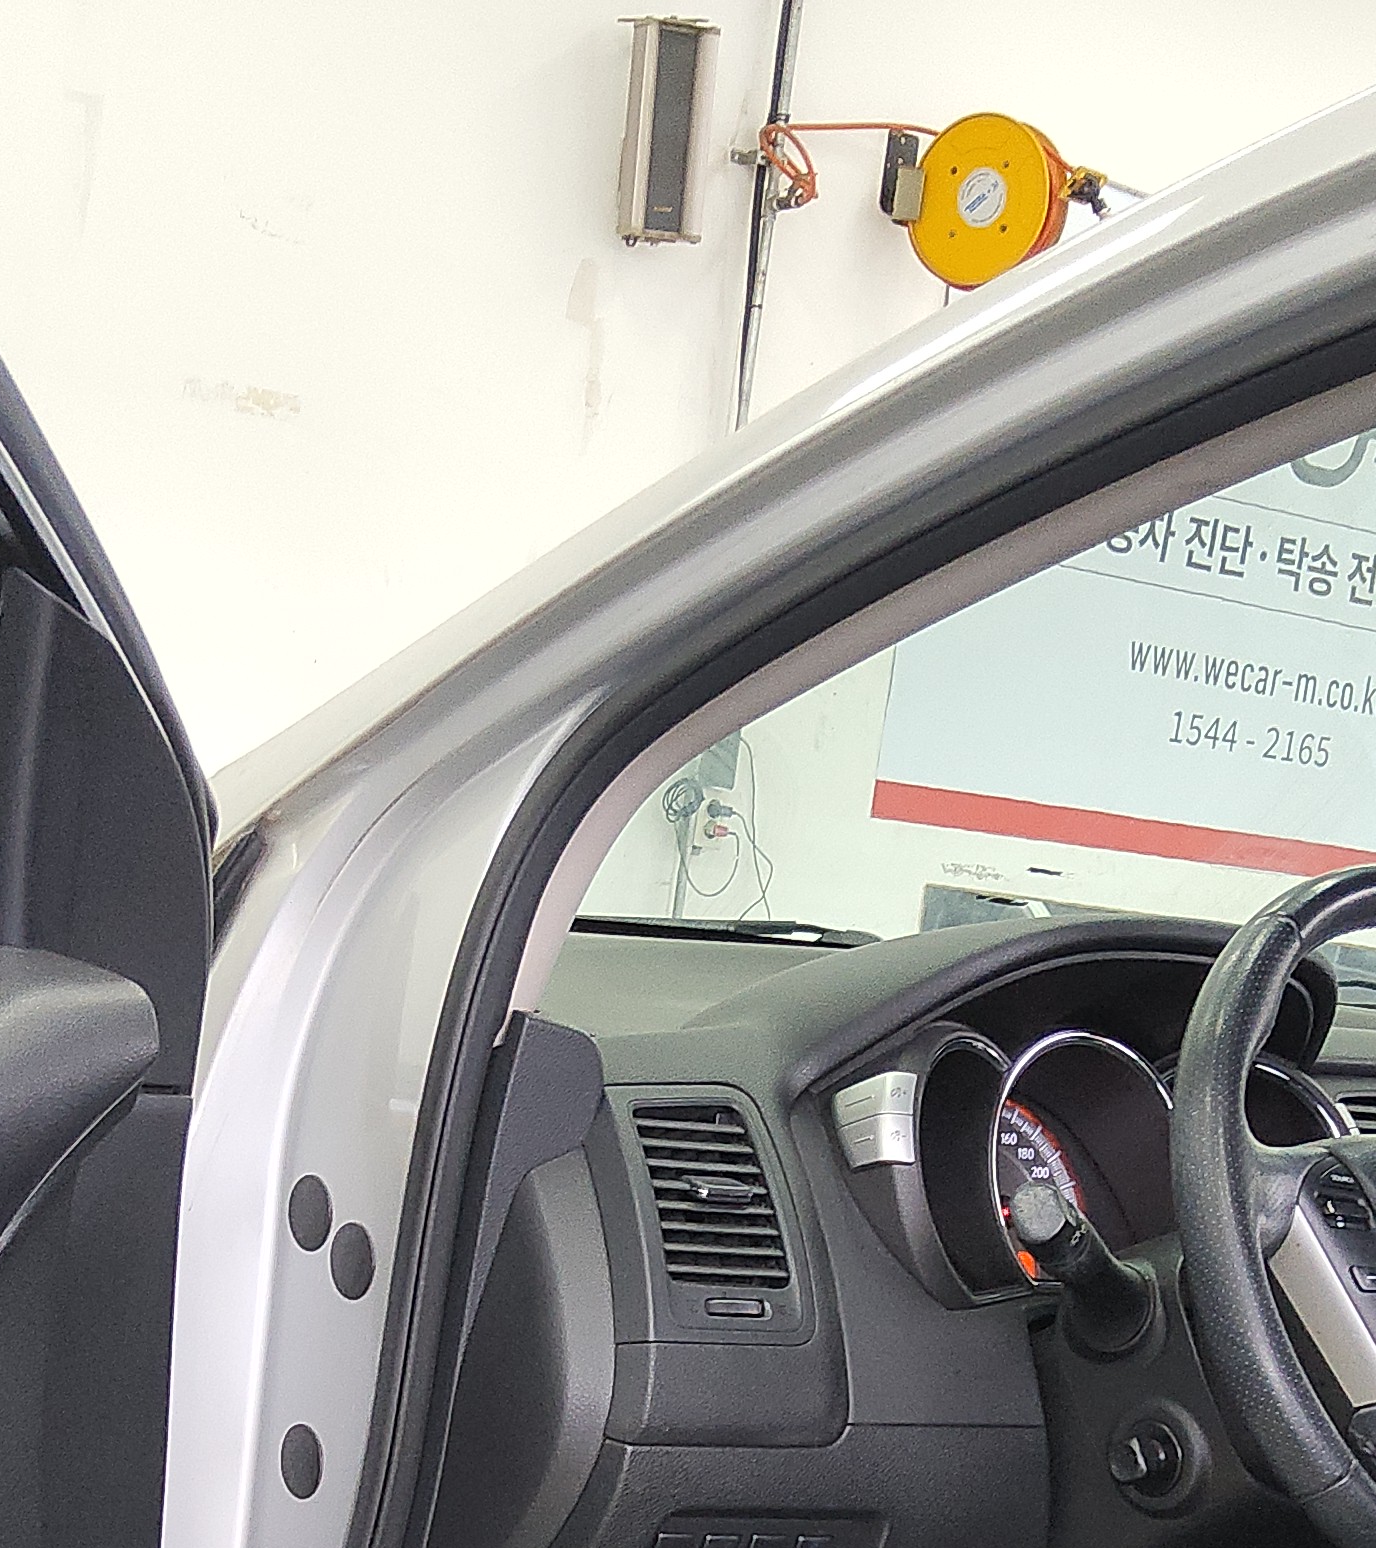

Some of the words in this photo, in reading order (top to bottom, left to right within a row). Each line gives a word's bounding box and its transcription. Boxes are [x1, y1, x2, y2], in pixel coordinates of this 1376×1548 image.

[1169, 710, 1239, 752] 1544
[1262, 726, 1332, 768] 2165
[1000, 1133, 1018, 1145] 160
[1017, 1147, 1035, 1160] 180
[1030, 1166, 1050, 1179] 200
